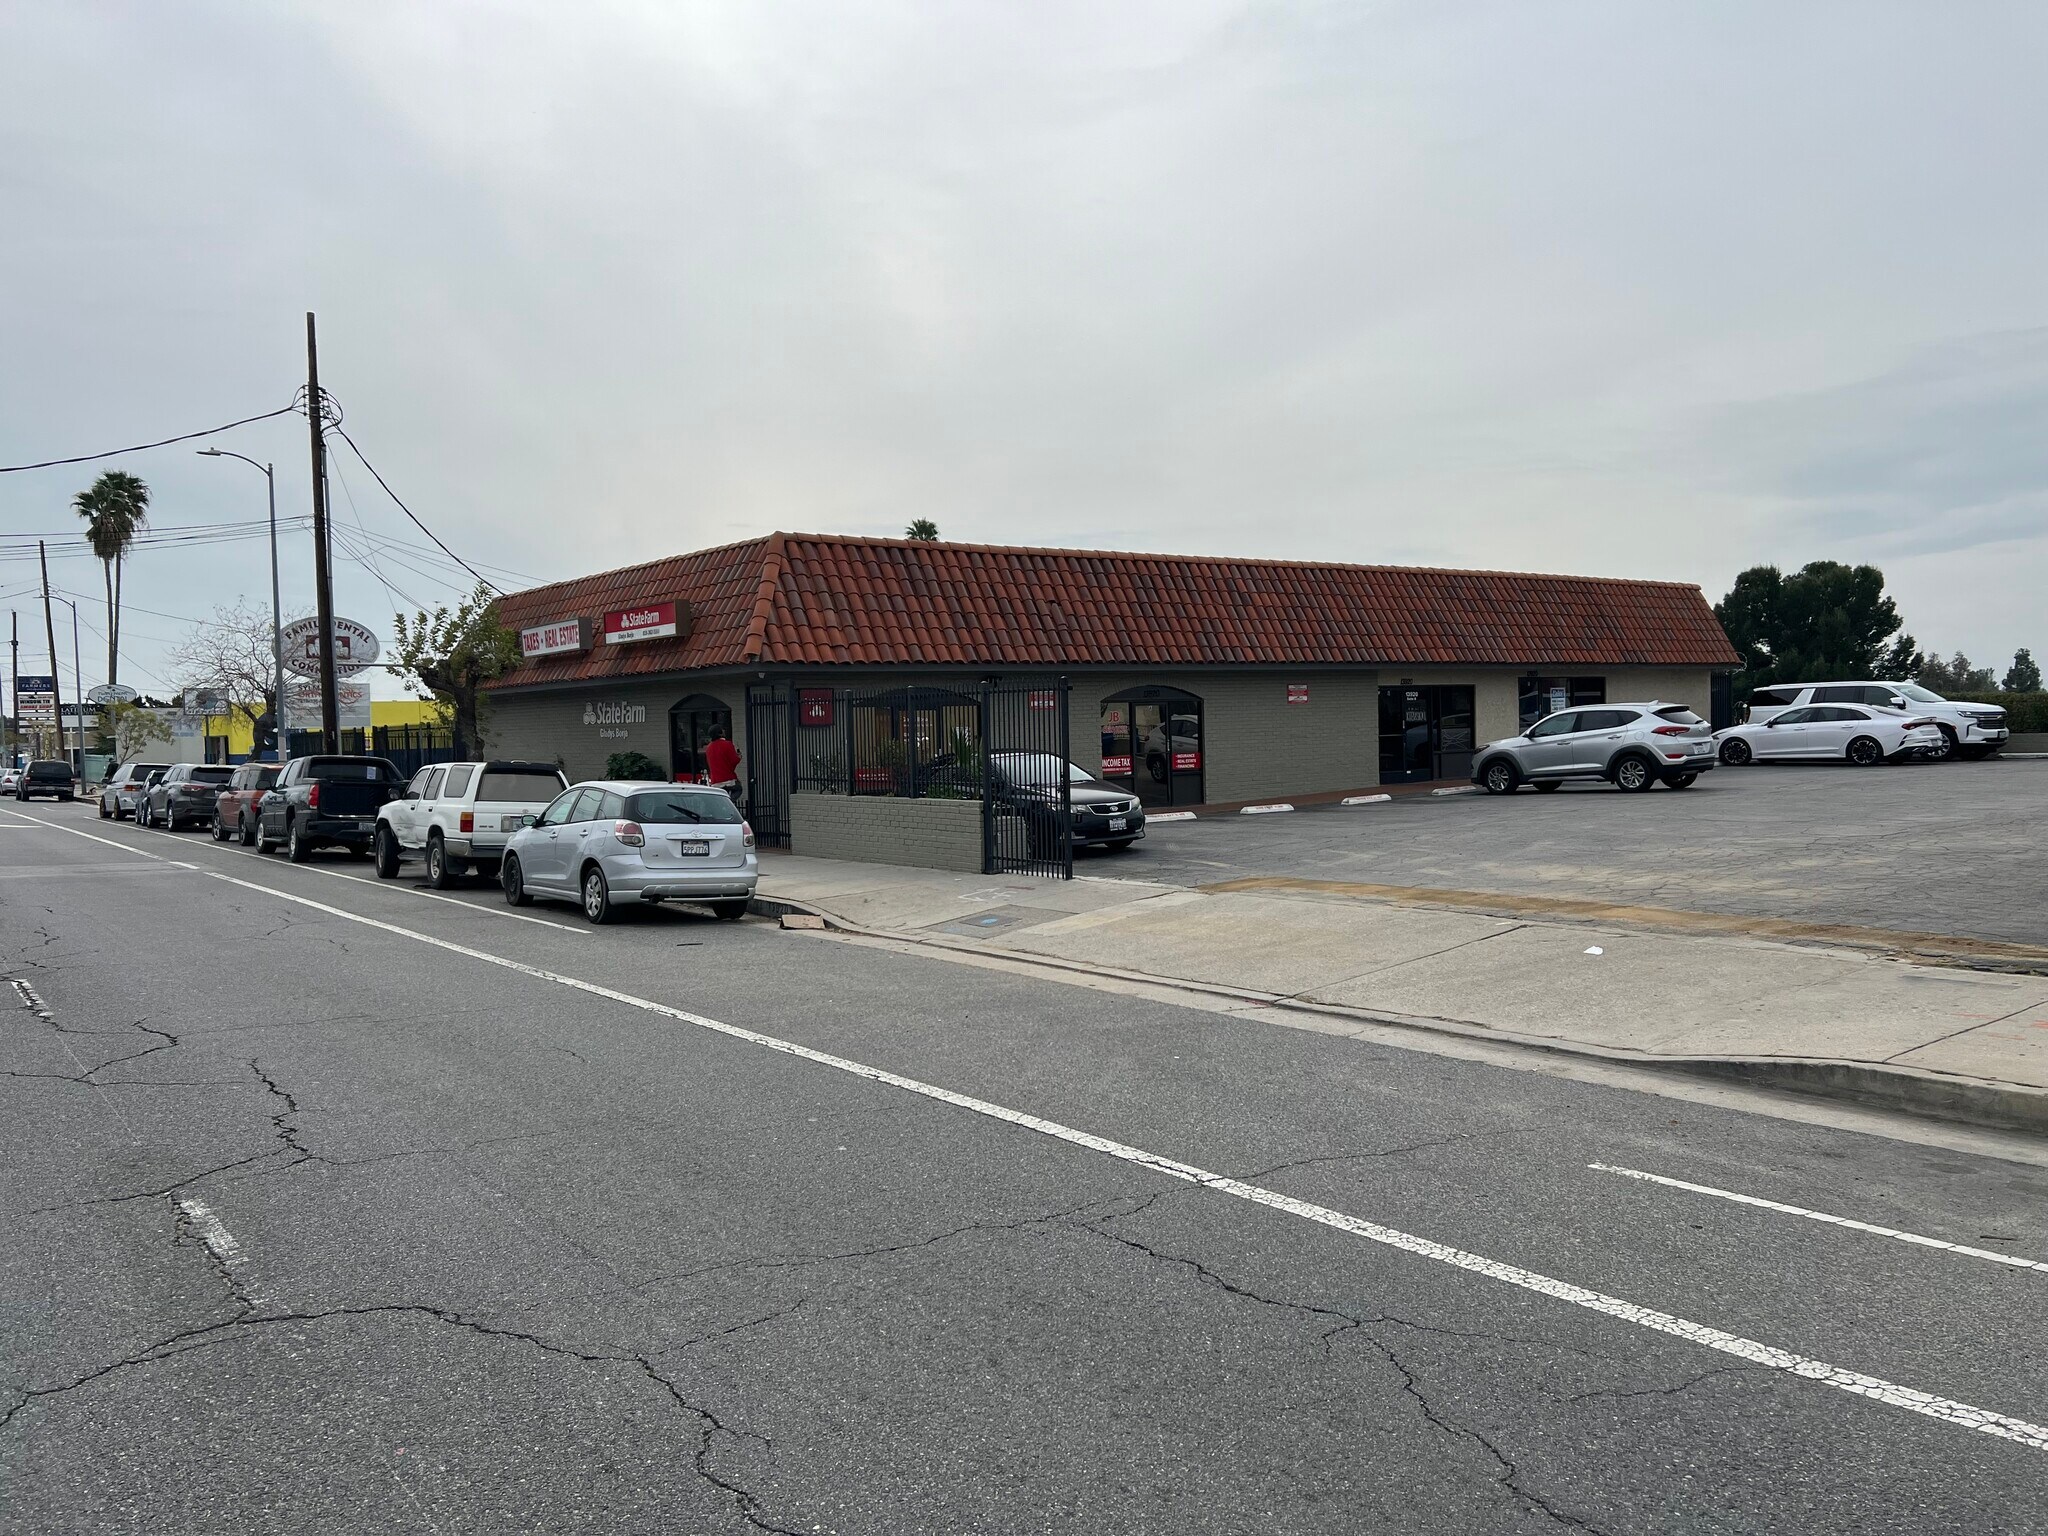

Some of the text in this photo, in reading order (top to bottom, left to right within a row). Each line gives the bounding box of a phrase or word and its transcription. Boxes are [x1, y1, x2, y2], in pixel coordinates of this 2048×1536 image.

[285, 620, 319, 640] FAMIL
[523, 624, 579, 652] TAXES REAL ESTATE
[291, 658, 362, 675] CONNTION
[1109, 711, 1120, 723] JB
[600, 728, 628, 739] Gladys Borja
[1102, 758, 1131, 767] INCOME TAX
